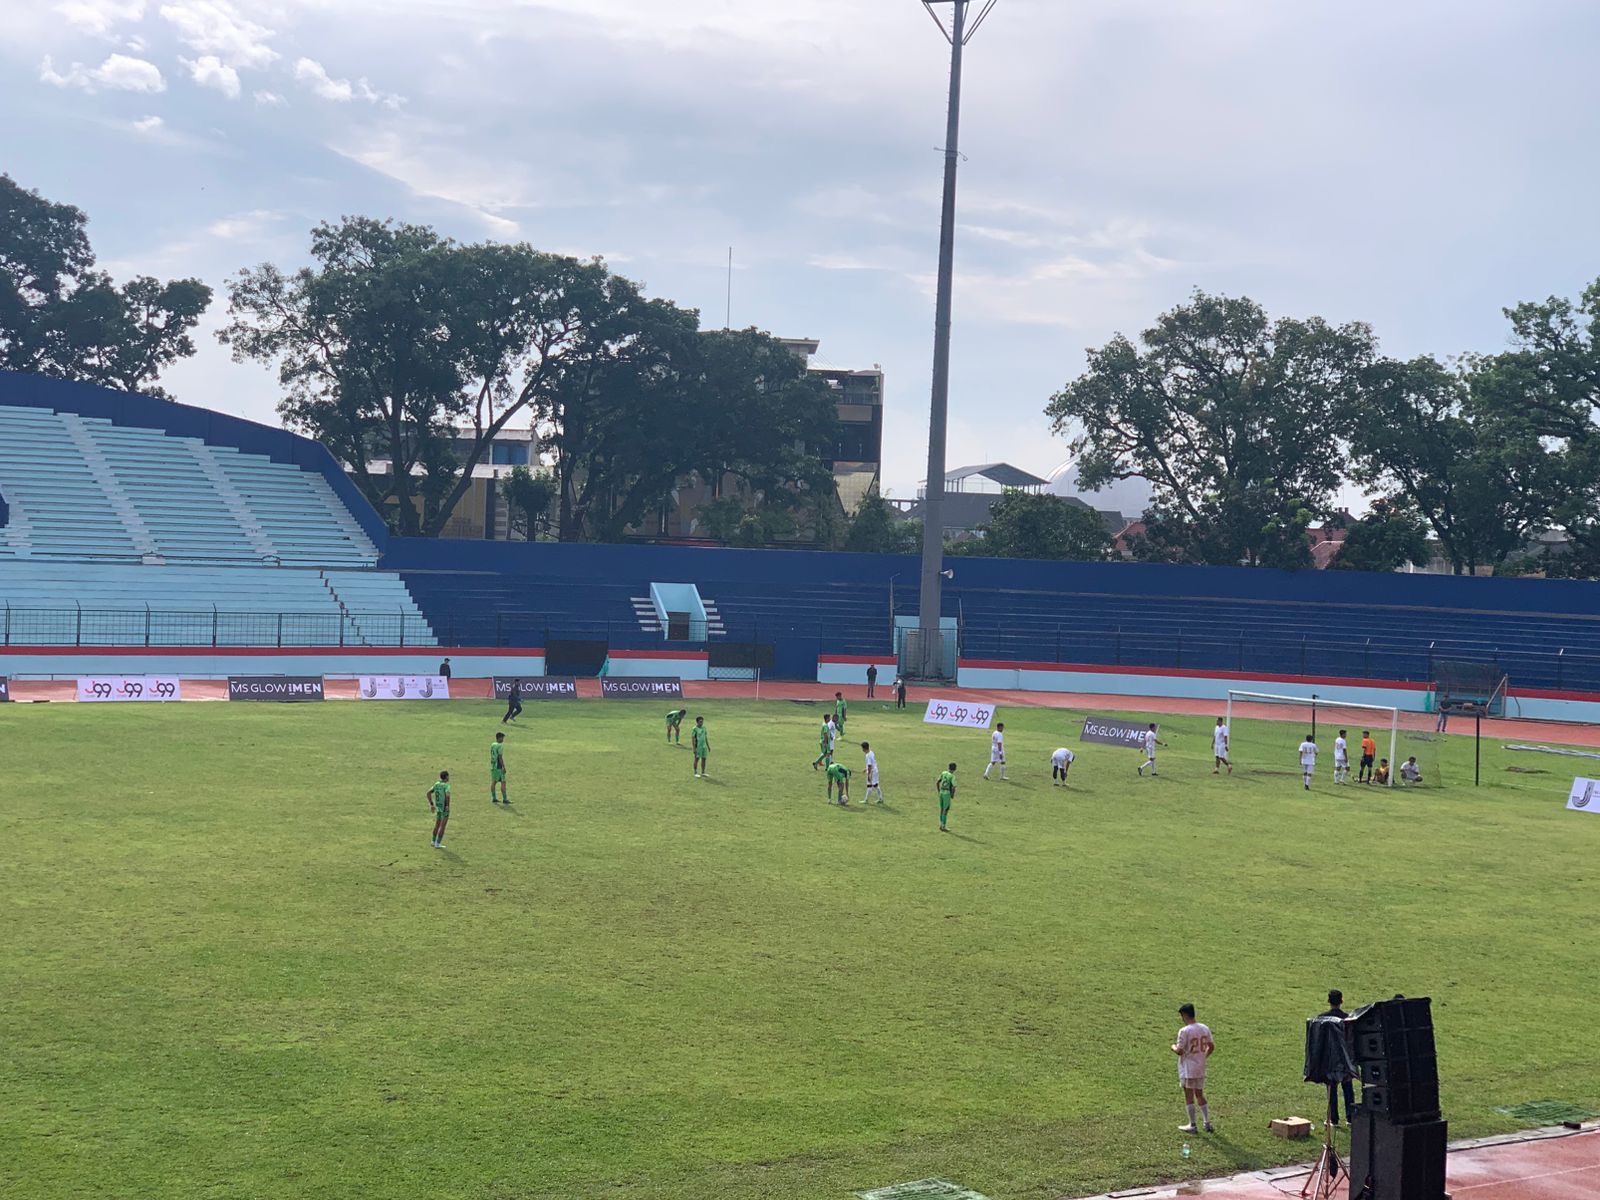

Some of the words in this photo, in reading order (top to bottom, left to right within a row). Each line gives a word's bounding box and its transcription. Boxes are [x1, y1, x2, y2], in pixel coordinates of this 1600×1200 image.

[231, 682, 249, 693] MS
[250, 683, 287, 693] GLOW
[496, 682, 512, 692] MS
[513, 682, 545, 692] LOW
[603, 682, 619, 692] MS
[620, 682, 651, 692] GLOW
[1084, 723, 1098, 735] MS
[1098, 726, 1127, 738] GLOW
